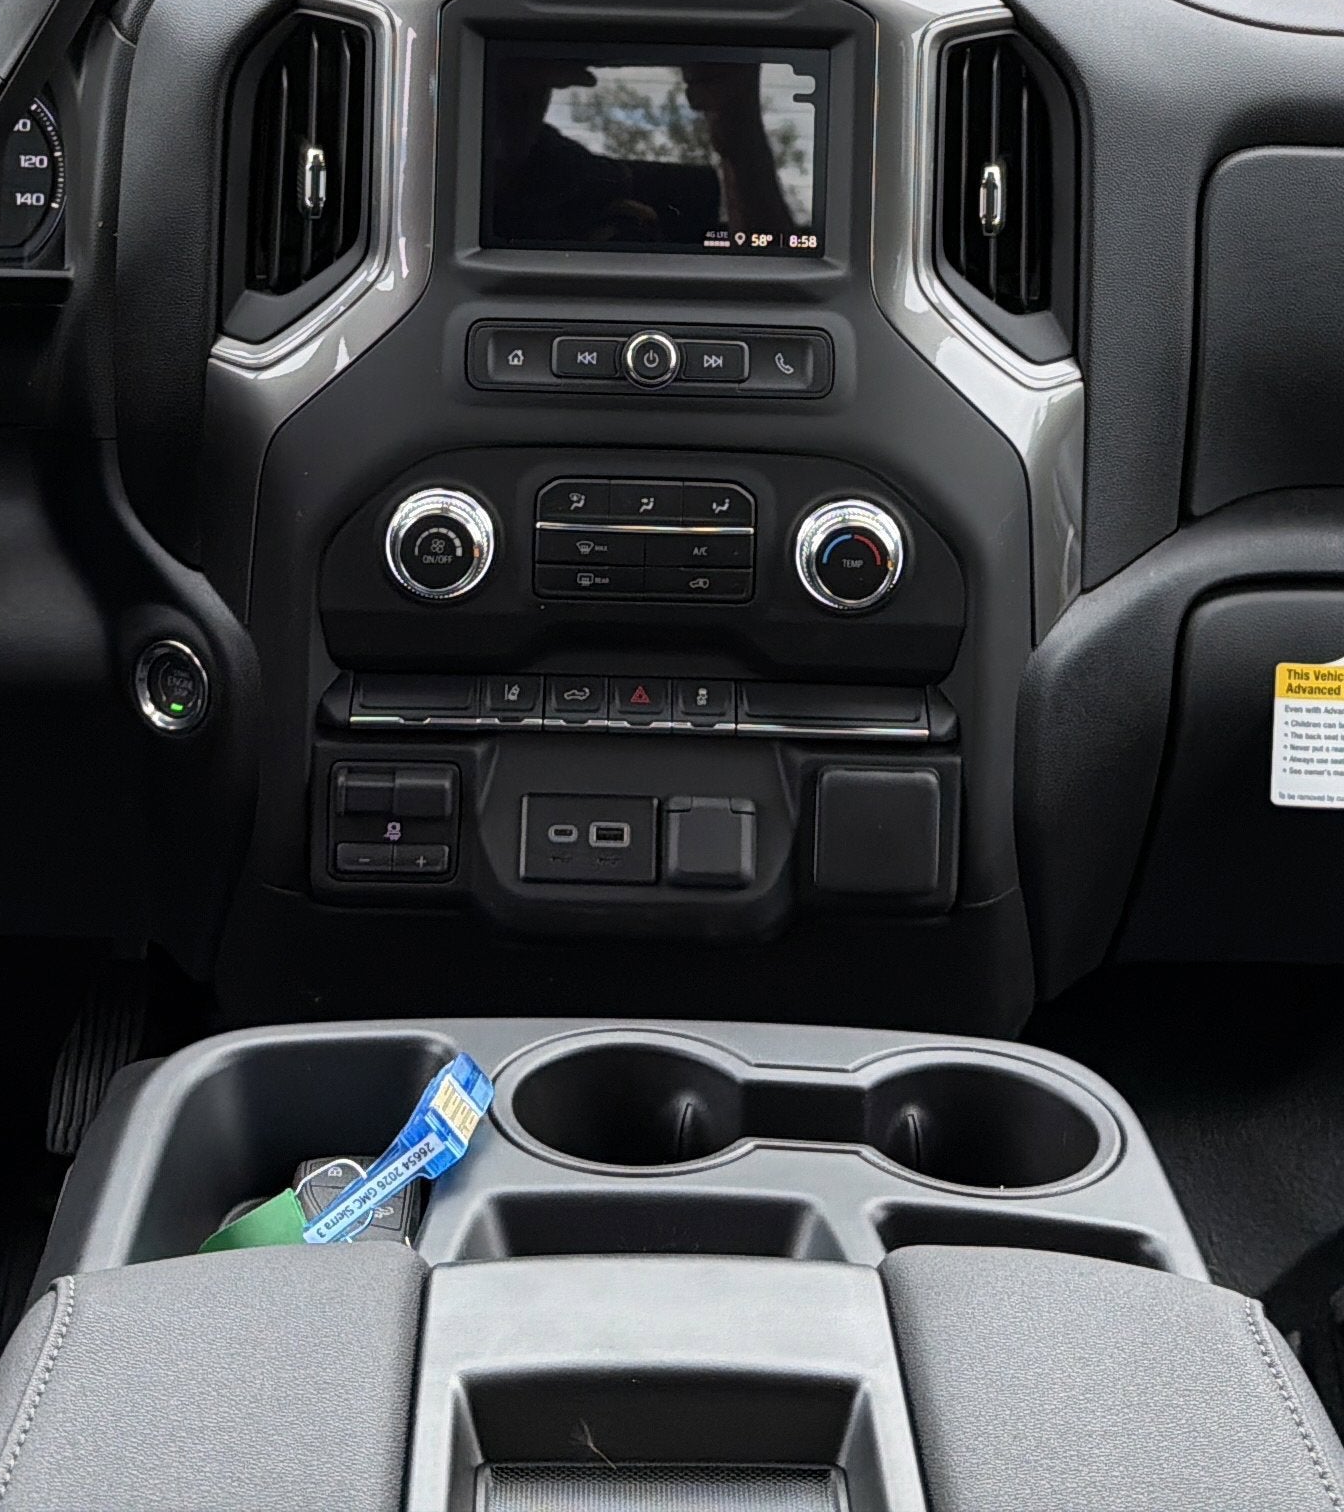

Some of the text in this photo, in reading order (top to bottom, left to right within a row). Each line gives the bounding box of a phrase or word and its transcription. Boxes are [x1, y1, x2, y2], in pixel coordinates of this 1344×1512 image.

[19, 155, 48, 168] 120
[15, 192, 45, 206] 140
[716, 231, 729, 239] LTE
[809, 234, 837, 248] 8:58
[693, 546, 708, 556] A/C
[422, 555, 453, 564] ON/OFF
[842, 558, 864, 568] TEMP
[1287, 669, 1310, 680] This
[1286, 684, 1341, 696] Advanced
[1285, 705, 1303, 713] Even
[1306, 706, 1321, 714] with
[1291, 720, 1321, 728] Children
[1289, 767, 1302, 775] See
[316, 1142, 436, 1239] 26654 2026 GMC Sierra 3
